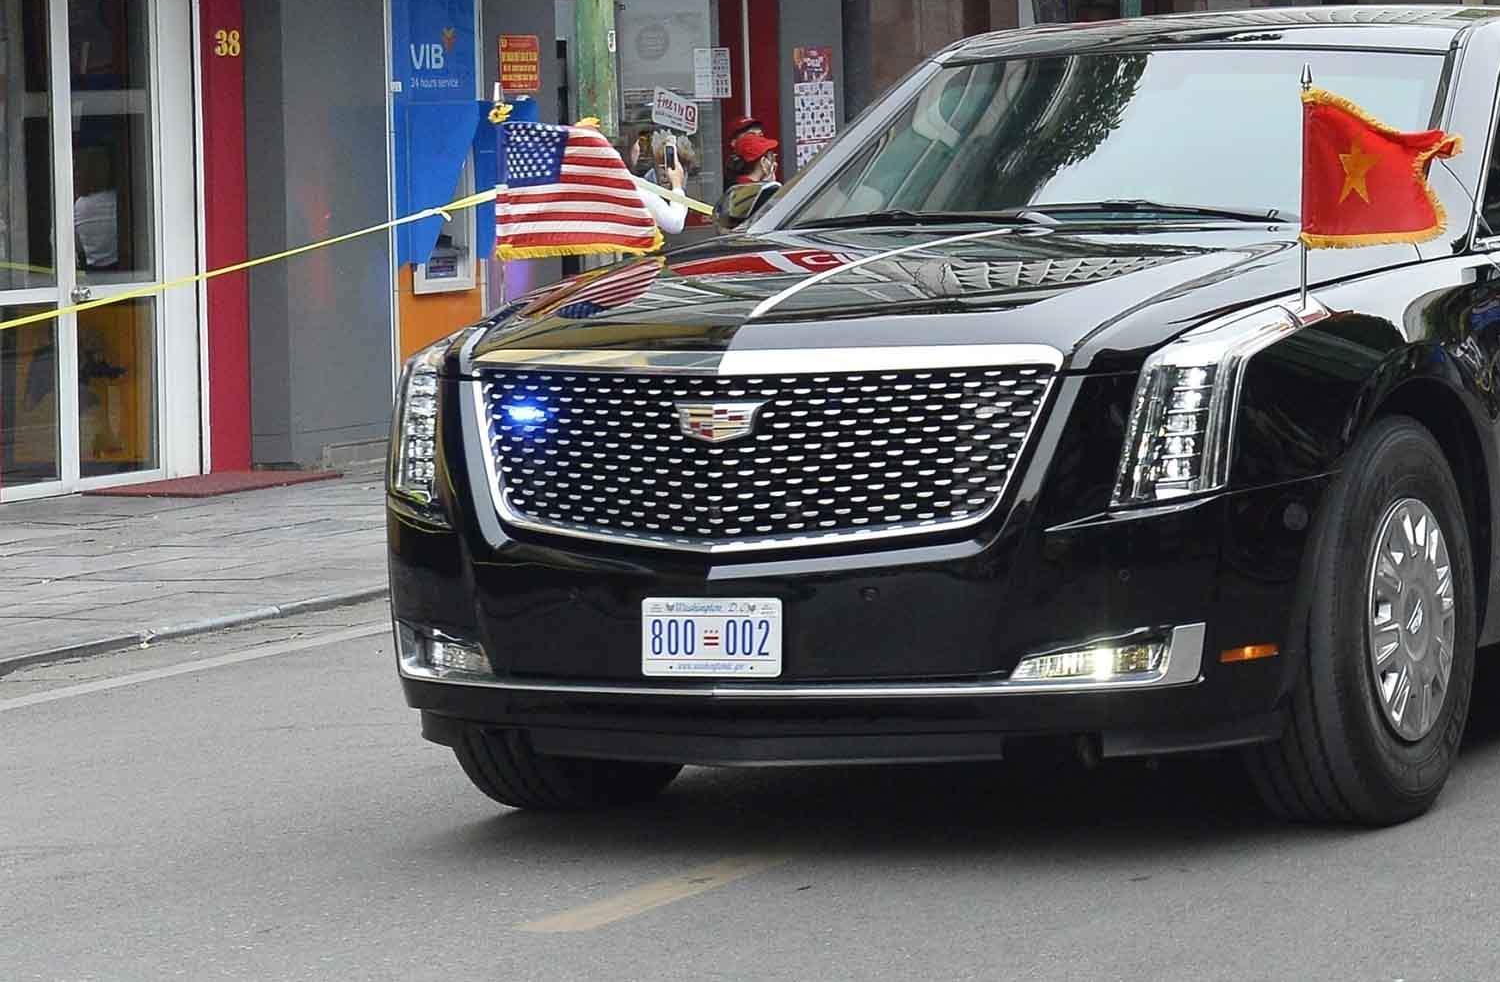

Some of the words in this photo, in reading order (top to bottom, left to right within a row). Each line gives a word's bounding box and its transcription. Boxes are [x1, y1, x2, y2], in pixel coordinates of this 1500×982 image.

[215, 29, 241, 57] 38
[410, 43, 445, 70] VIB
[651, 619, 695, 656] 800
[725, 619, 770, 657] 002
